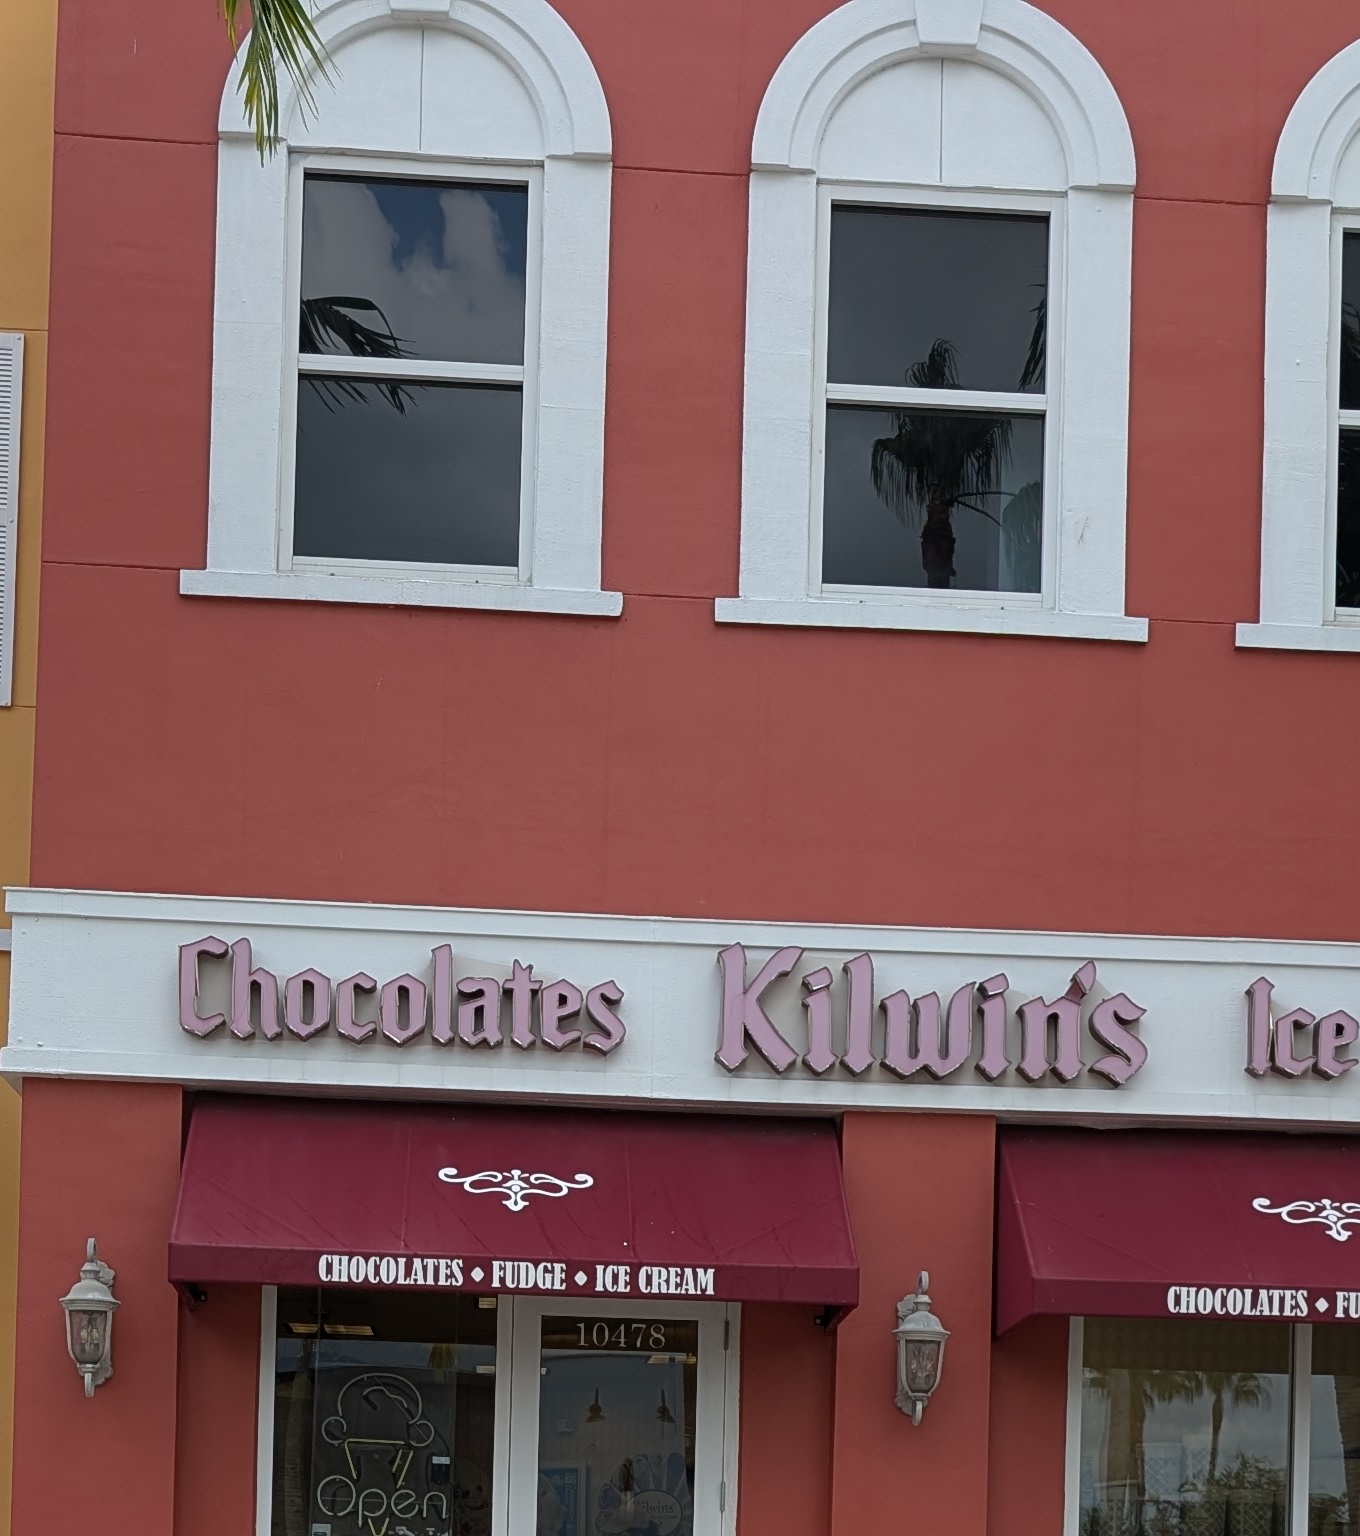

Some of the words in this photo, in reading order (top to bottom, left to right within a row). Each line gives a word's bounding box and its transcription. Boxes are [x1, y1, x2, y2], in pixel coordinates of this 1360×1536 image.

[178, 935, 626, 1057] Chocolates
[715, 941, 1150, 1088] Kilwin's
[1244, 976, 1360, 1081] Ice
[318, 1253, 464, 1288] CHOCOLATES
[492, 1260, 568, 1291] FUDGE
[595, 1264, 631, 1294] ICE
[639, 1266, 715, 1297] CREAM
[1166, 1286, 1309, 1317] CHOCOLATES
[576, 1322, 666, 1349] 10478
[316, 1475, 448, 1529] Open
